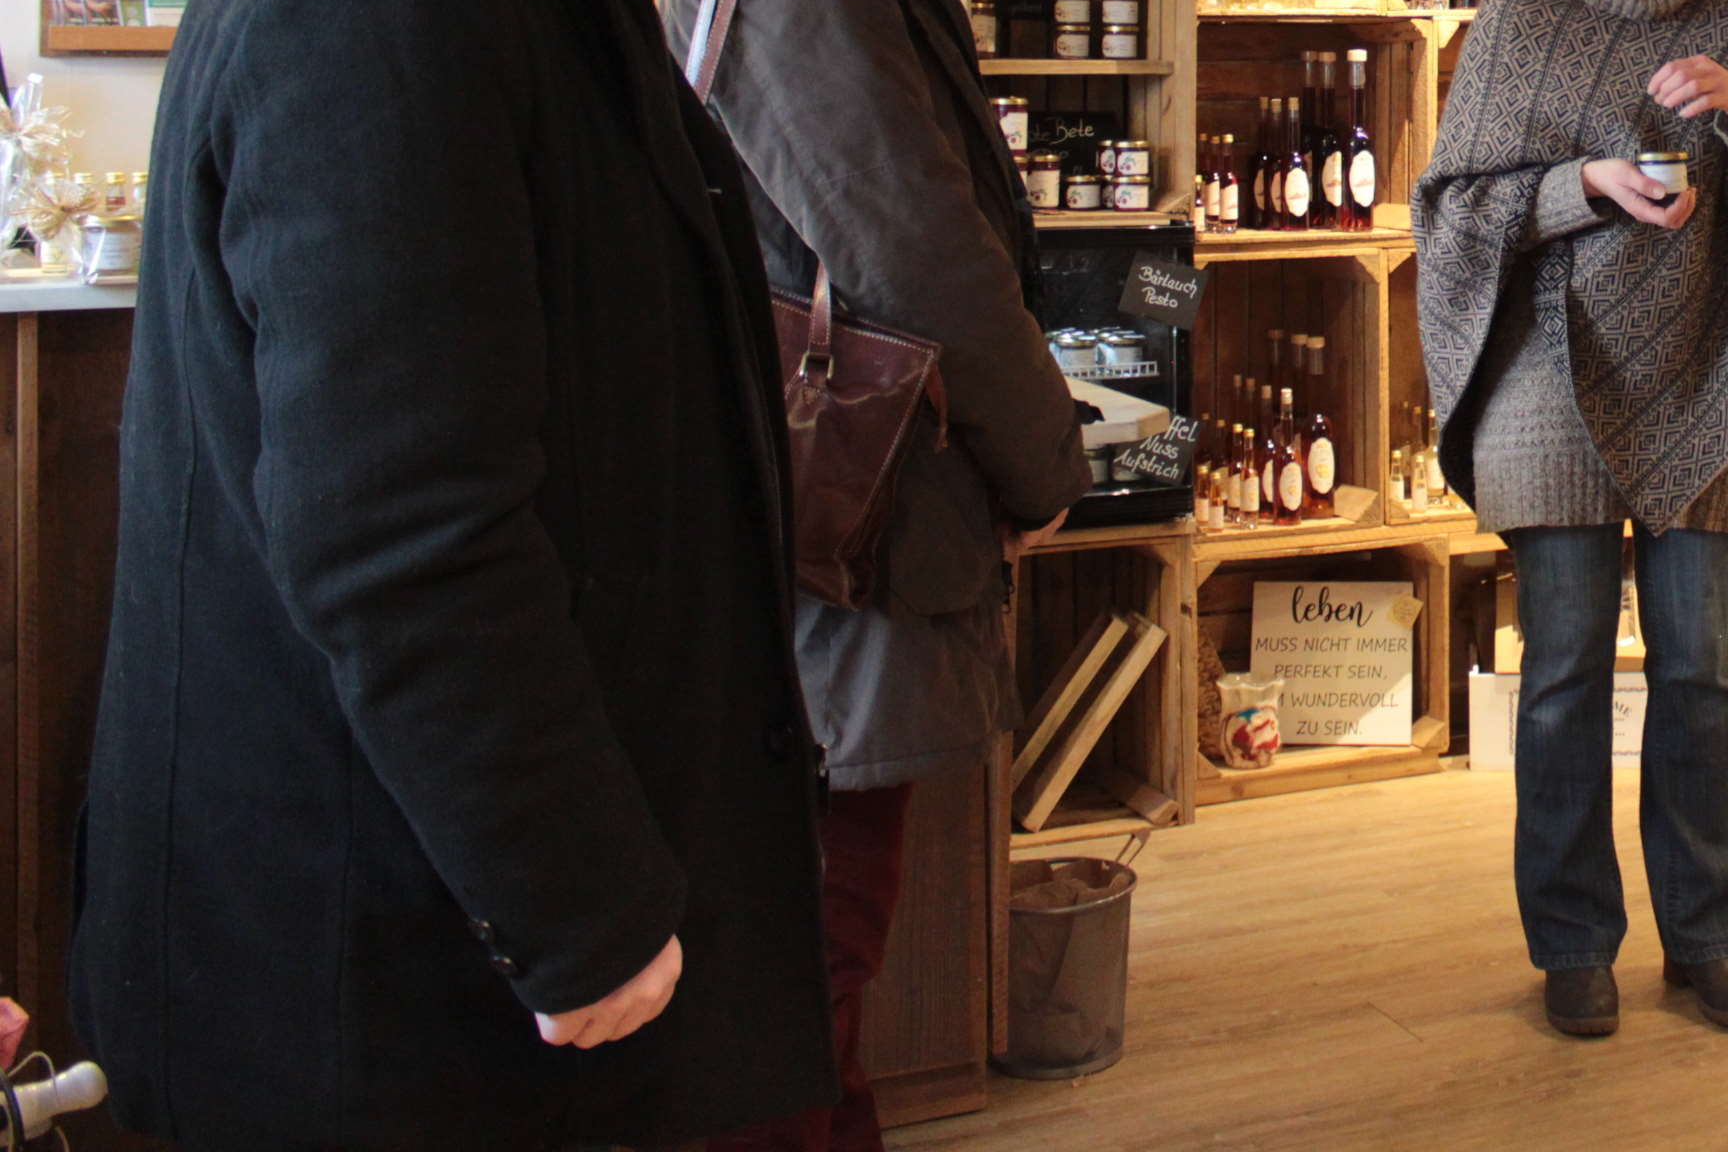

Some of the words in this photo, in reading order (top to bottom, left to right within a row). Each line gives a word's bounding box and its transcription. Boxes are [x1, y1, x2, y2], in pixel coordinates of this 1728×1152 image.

[1138, 266, 1197, 299] Bärlauch
[1141, 286, 1178, 308] Pesto
[1140, 435, 1179, 459] Nuss
[1113, 448, 1180, 479] Aufstrich
[1292, 586, 1373, 627] leben
[1255, 636, 1298, 652] MUSS
[1303, 637, 1351, 652] NICHT
[1356, 637, 1409, 653] IMMER
[1274, 664, 1344, 679] PERFEKT
[1290, 692, 1400, 708] WUNDERVOLL
[1296, 721, 1319, 735] ZU
